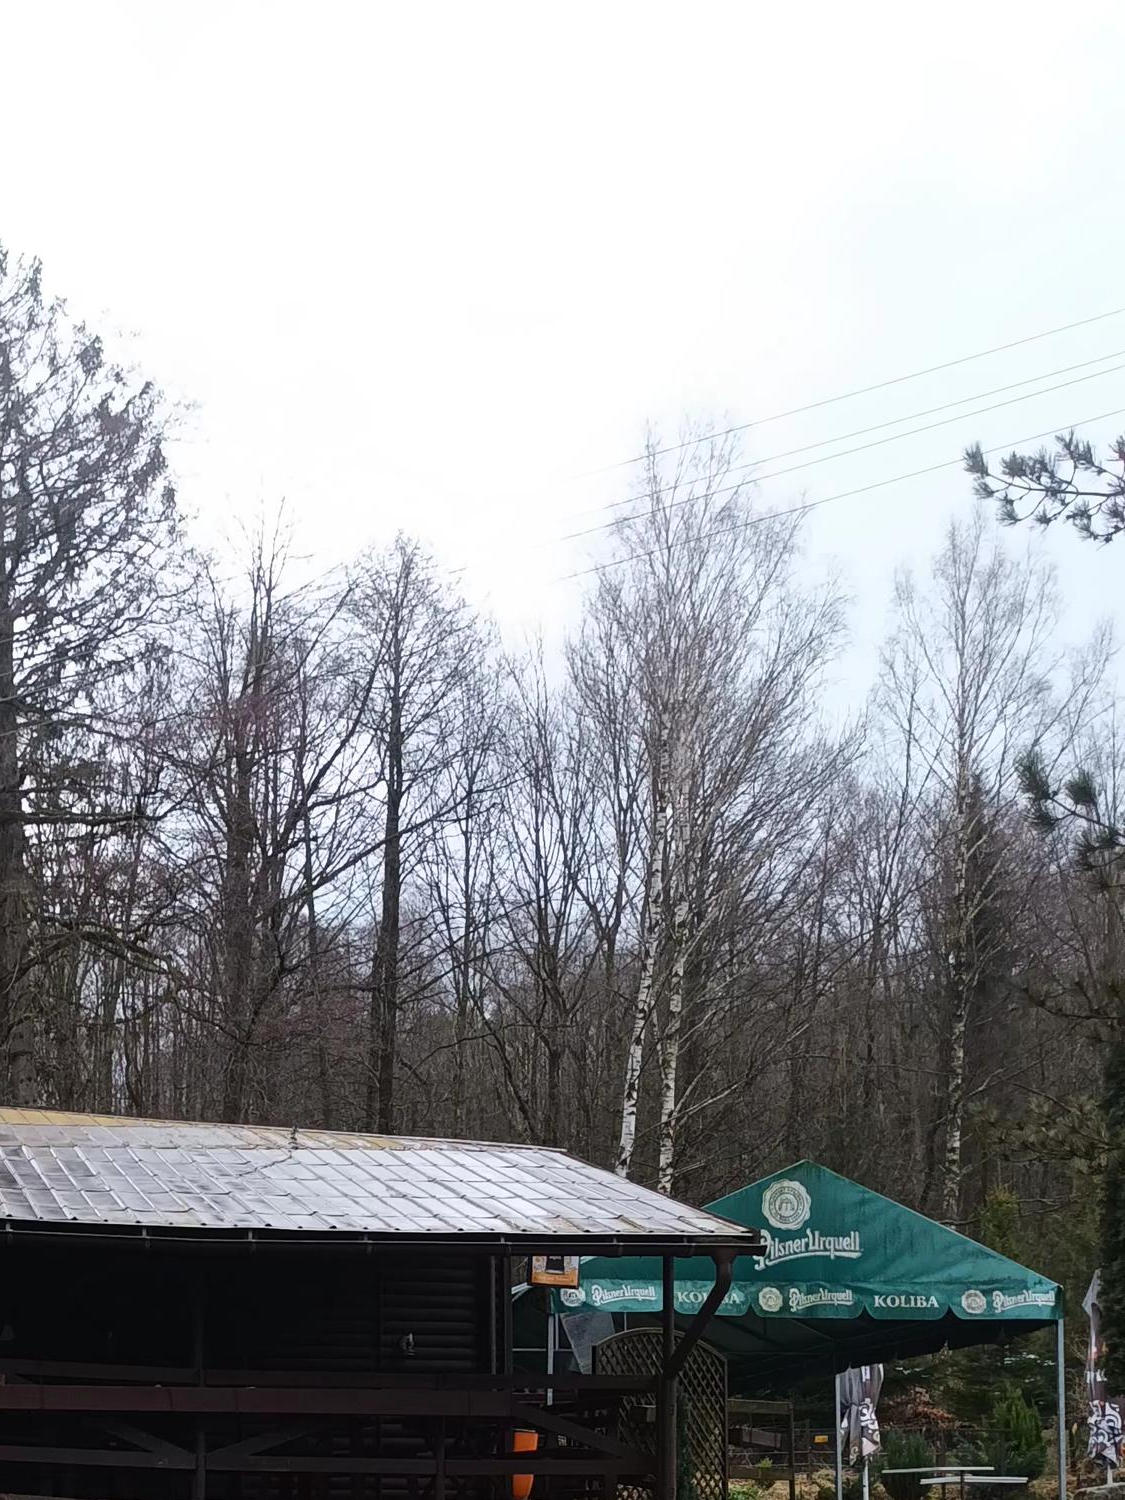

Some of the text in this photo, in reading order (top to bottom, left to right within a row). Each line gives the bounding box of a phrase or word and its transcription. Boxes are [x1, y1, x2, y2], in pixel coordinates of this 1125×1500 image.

[753, 1228, 863, 1271] Pilsner Urquell
[591, 1284, 623, 1307] Pilsner
[622, 1284, 657, 1301] Urquell
[789, 1287, 821, 1312] Pilsner
[819, 1287, 853, 1306] Urquell
[875, 1294, 939, 1308] KOLIBA
[992, 1290, 1025, 1313] Pilsner
